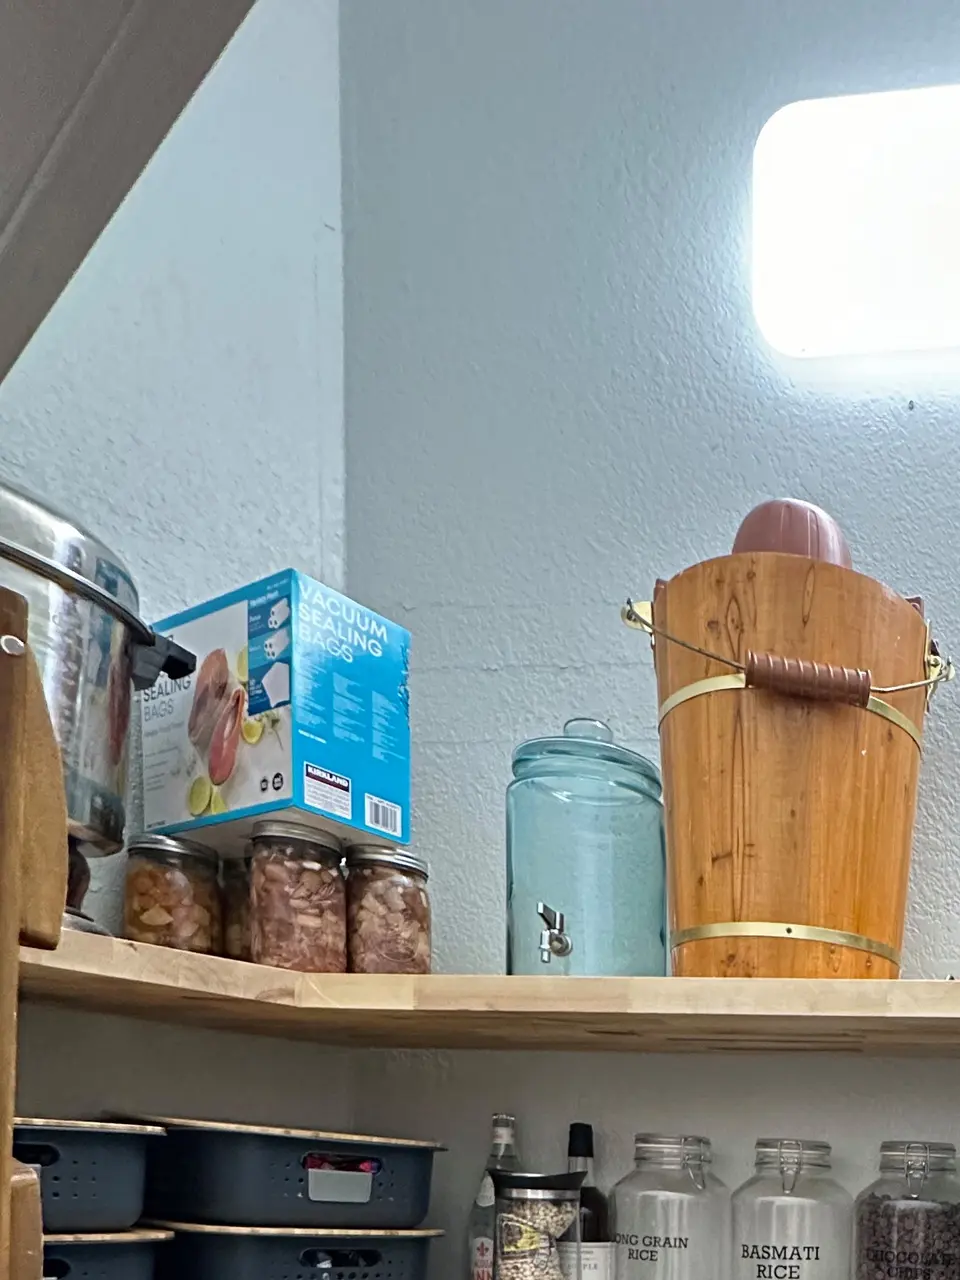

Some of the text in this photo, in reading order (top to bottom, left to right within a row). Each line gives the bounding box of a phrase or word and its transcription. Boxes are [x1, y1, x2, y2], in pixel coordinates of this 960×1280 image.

[299, 580, 389, 643] VACUUM
[299, 602, 383, 657] SEALING
[299, 623, 353, 663] BAGS
[143, 672, 191, 702] SEALING
[143, 699, 175, 722] BAGS
[615, 1233, 690, 1250] ONG GRAIN
[740, 1243, 821, 1261] BASMATI
[627, 1249, 659, 1262] RICE
[756, 1264, 801, 1280] RICE
